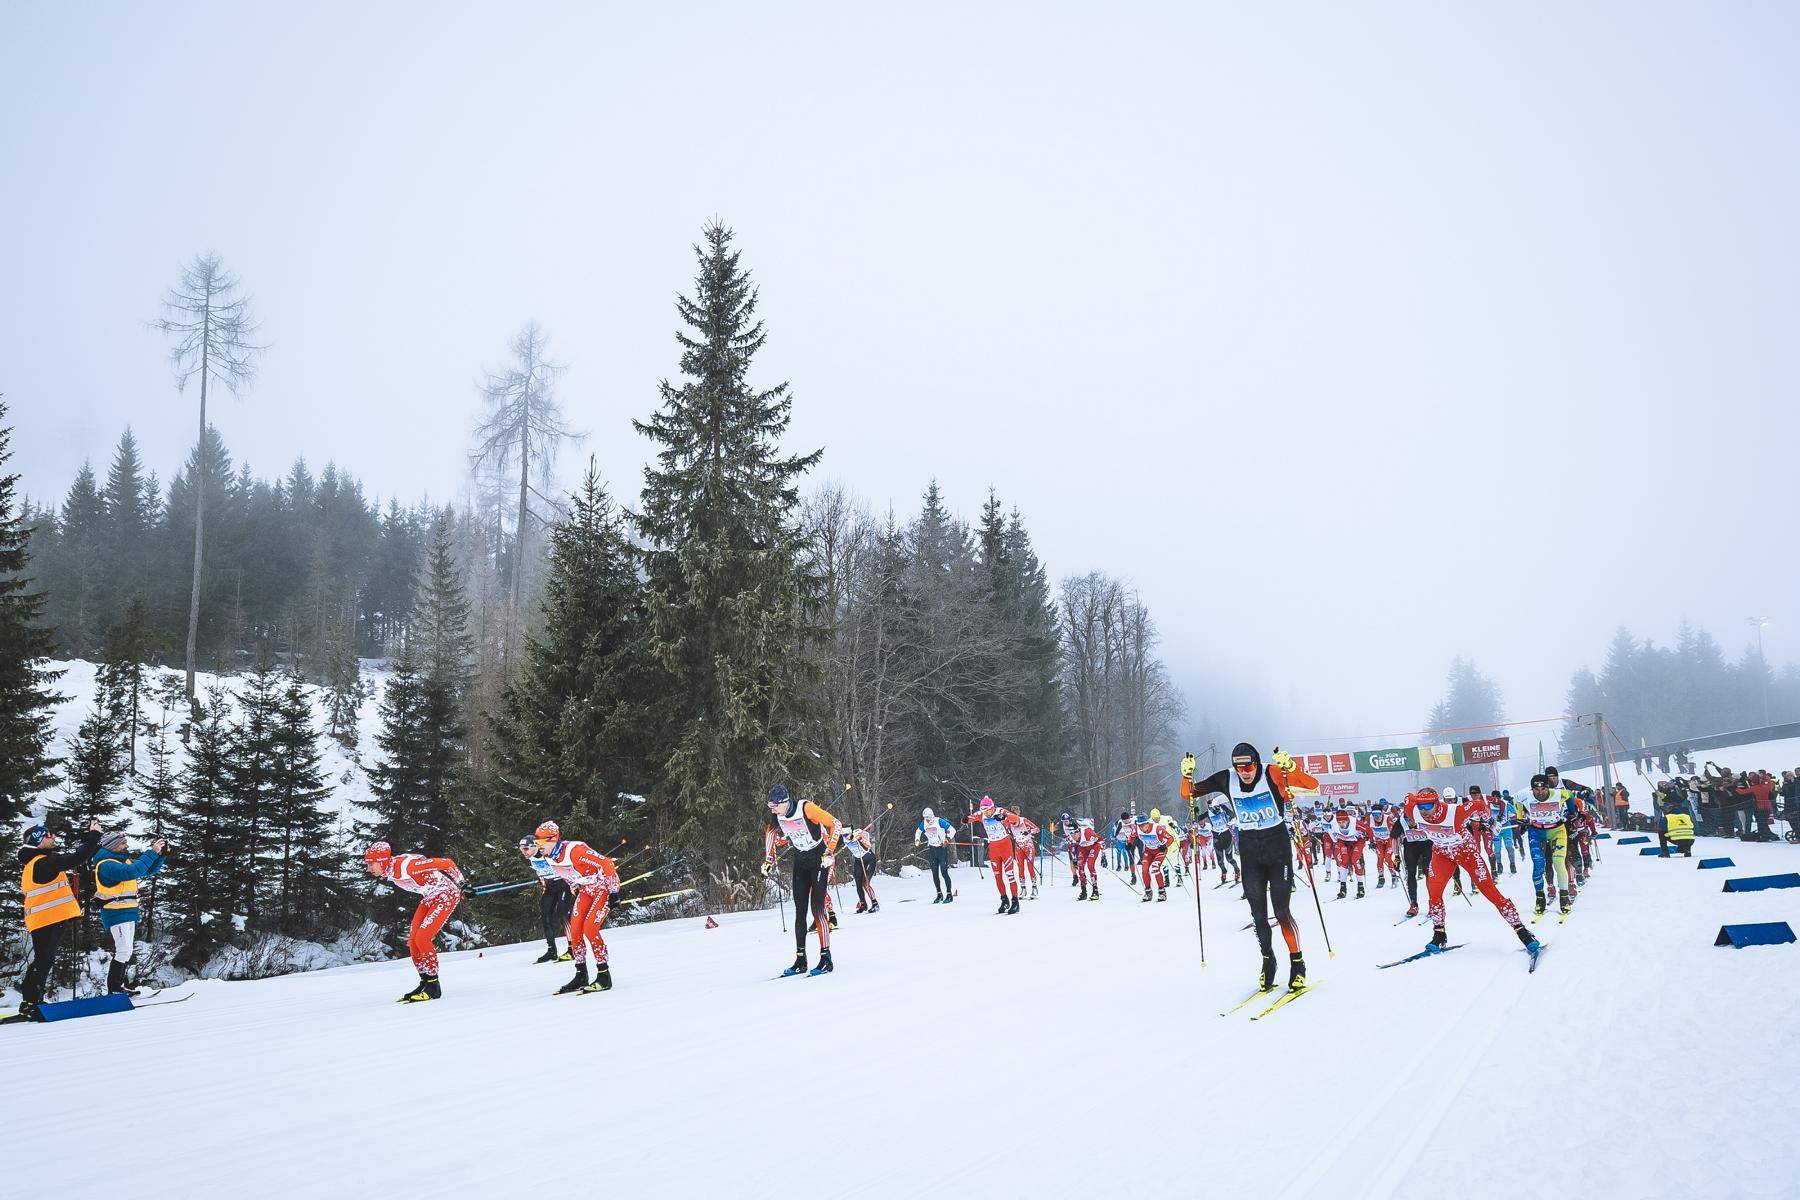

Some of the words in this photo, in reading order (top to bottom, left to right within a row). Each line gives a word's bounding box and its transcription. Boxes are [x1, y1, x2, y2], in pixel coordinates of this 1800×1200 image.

[1471, 744, 1501, 753] KLEINE
[1472, 750, 1501, 759] ZEITUNG
[1369, 754, 1407, 770] Gösser
[1241, 806, 1275, 822] 2010
